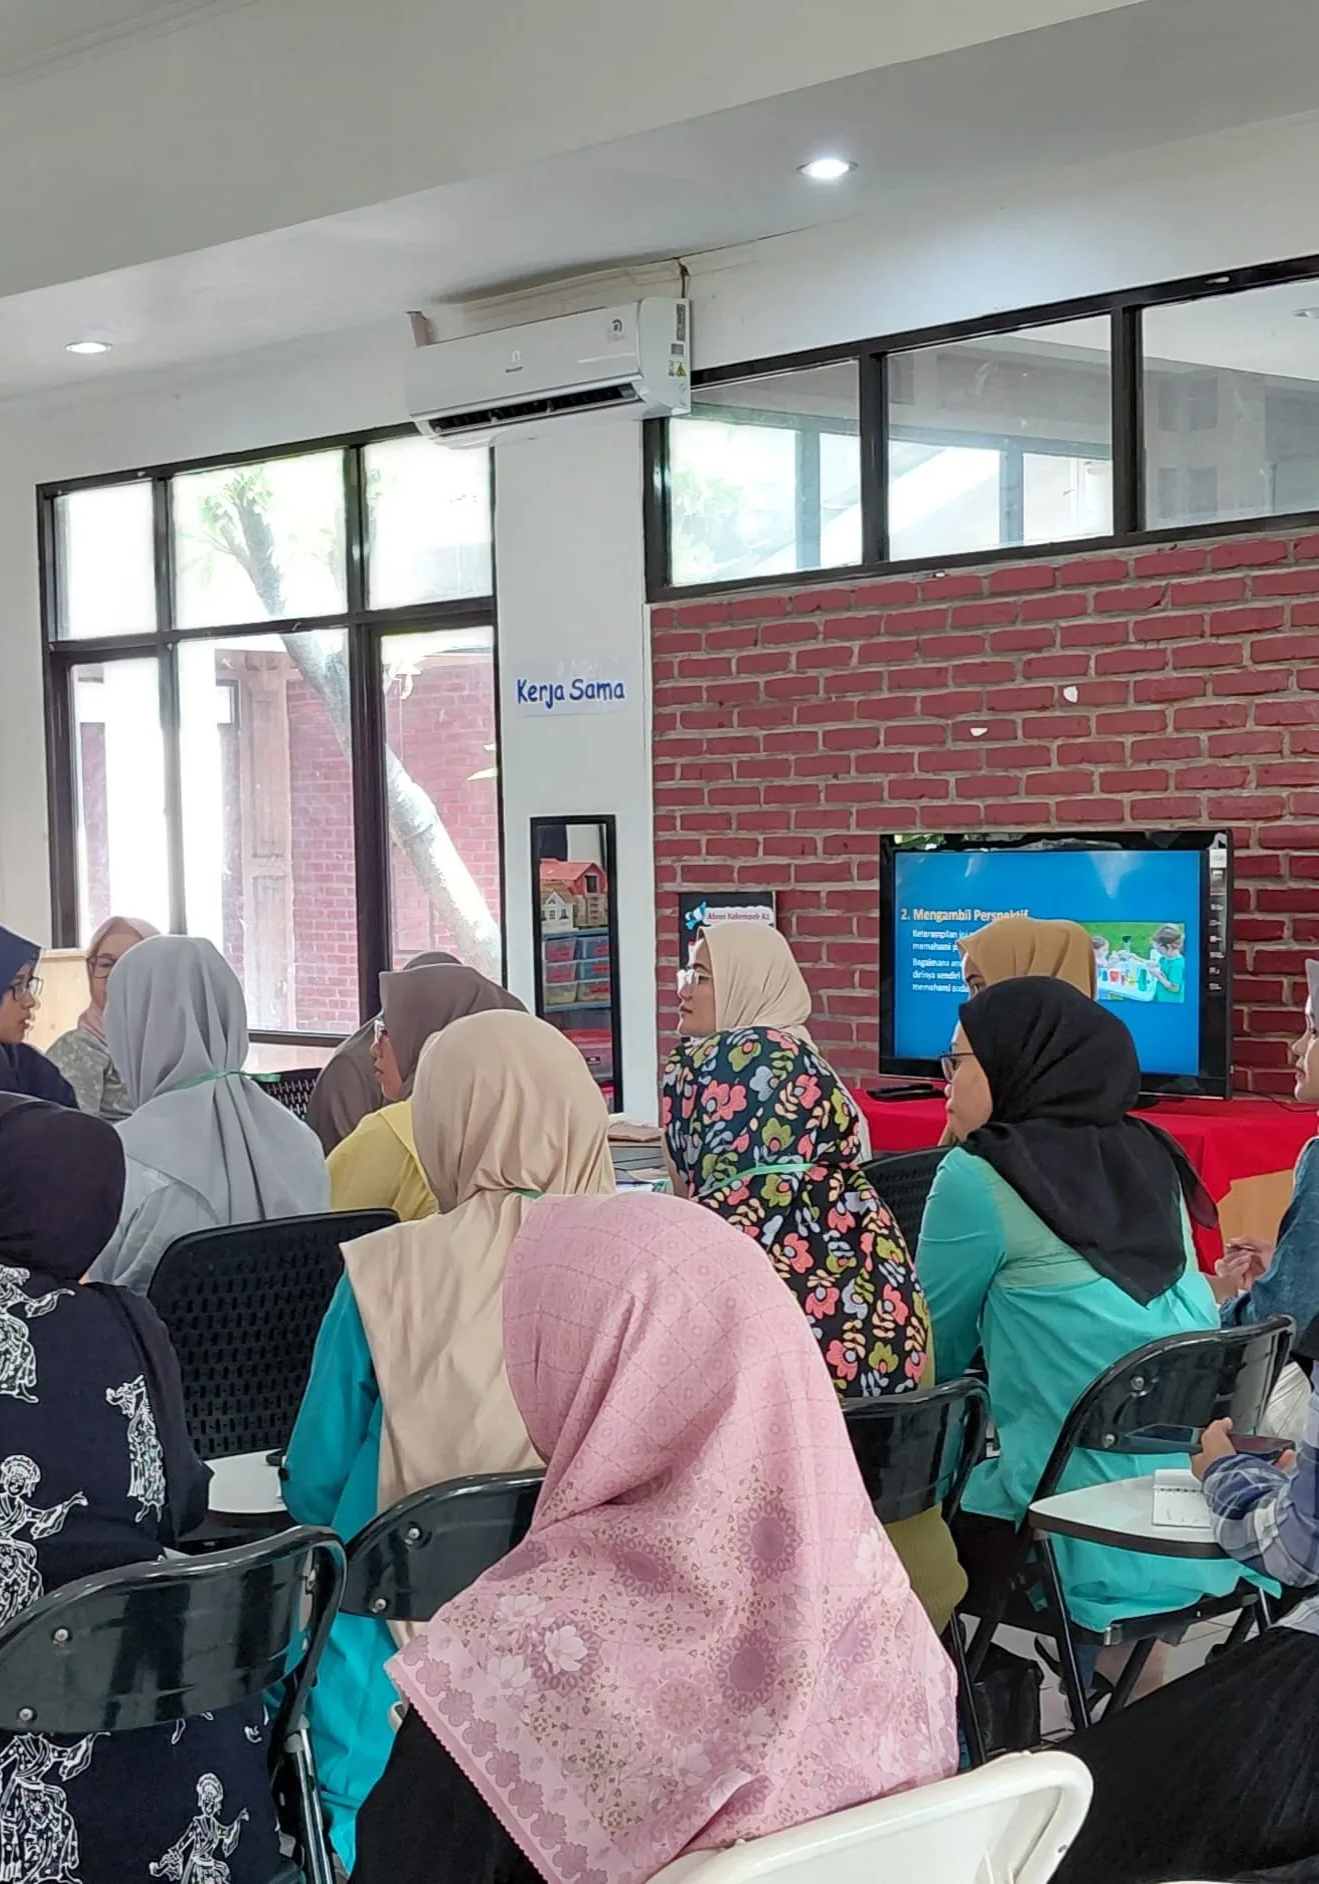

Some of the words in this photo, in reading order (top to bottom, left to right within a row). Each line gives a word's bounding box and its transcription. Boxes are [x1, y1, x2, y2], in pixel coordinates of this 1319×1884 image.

[517, 679, 565, 709] Kerja
[570, 679, 625, 700] Sama
[901, 909, 910, 920] 2.
[913, 909, 971, 922] Mengambil
